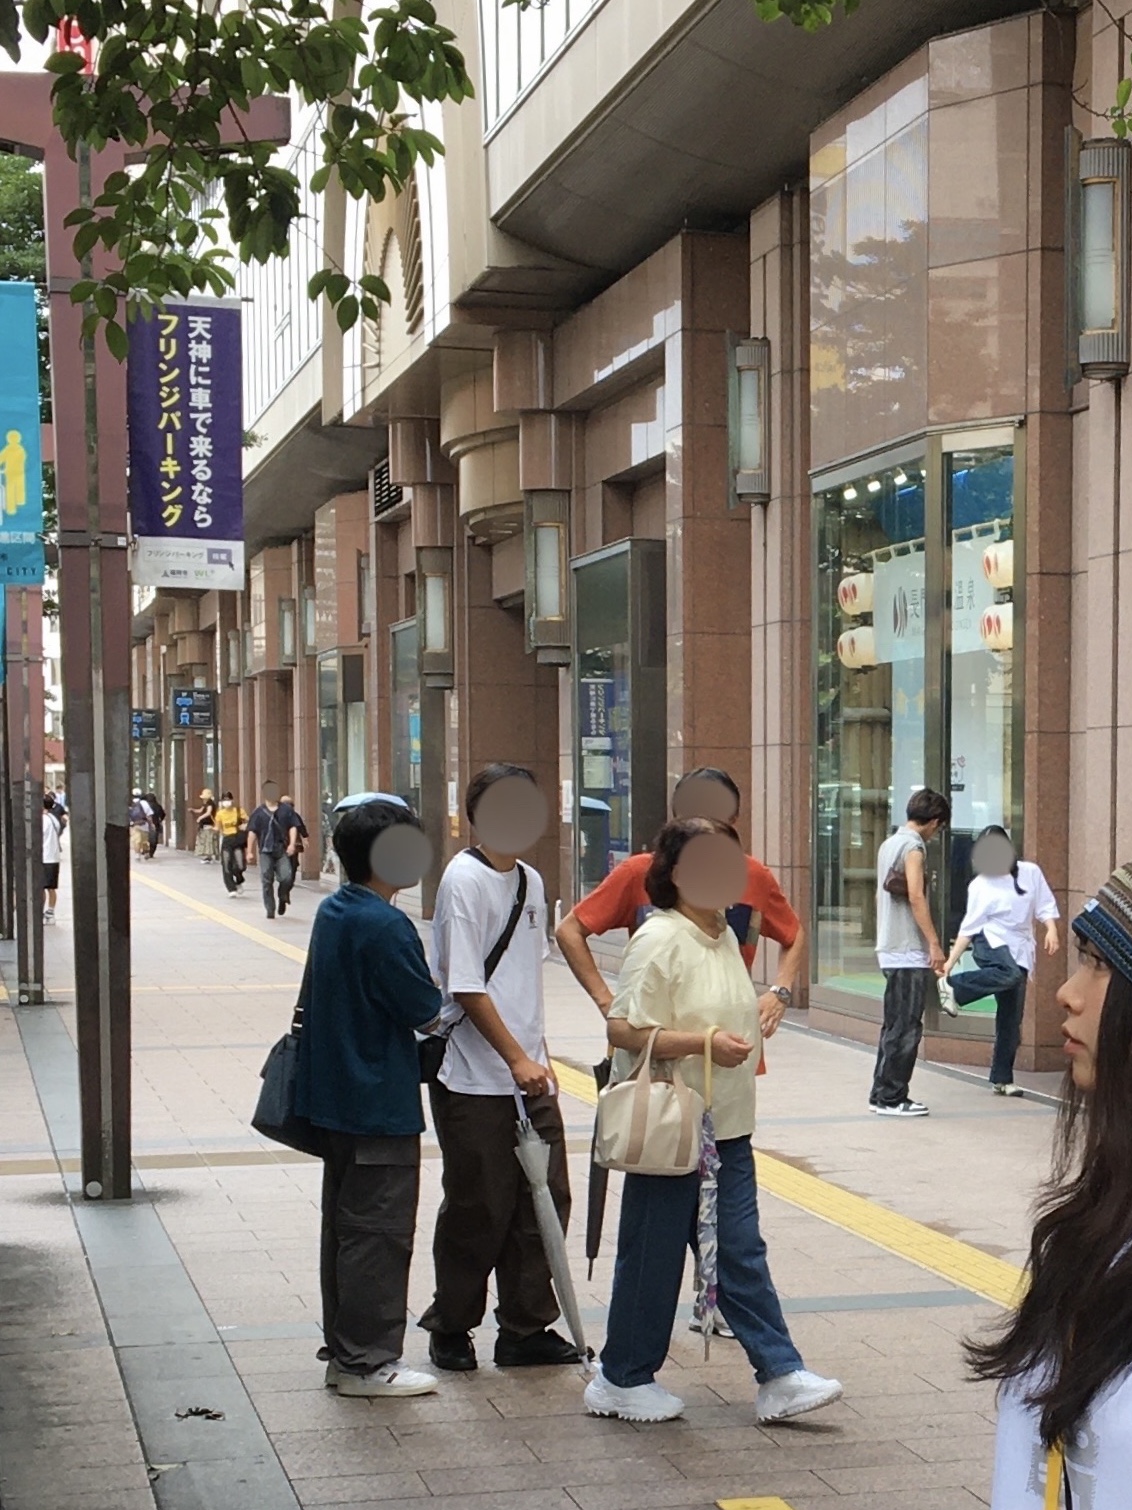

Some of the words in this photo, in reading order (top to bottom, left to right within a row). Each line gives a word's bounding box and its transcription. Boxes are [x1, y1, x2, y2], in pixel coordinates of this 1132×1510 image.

[157, 313, 184, 529] フリンジパーキング
[187, 315, 214, 529] 天神に車で来るなら
[7, 566, 37, 576] CITY
